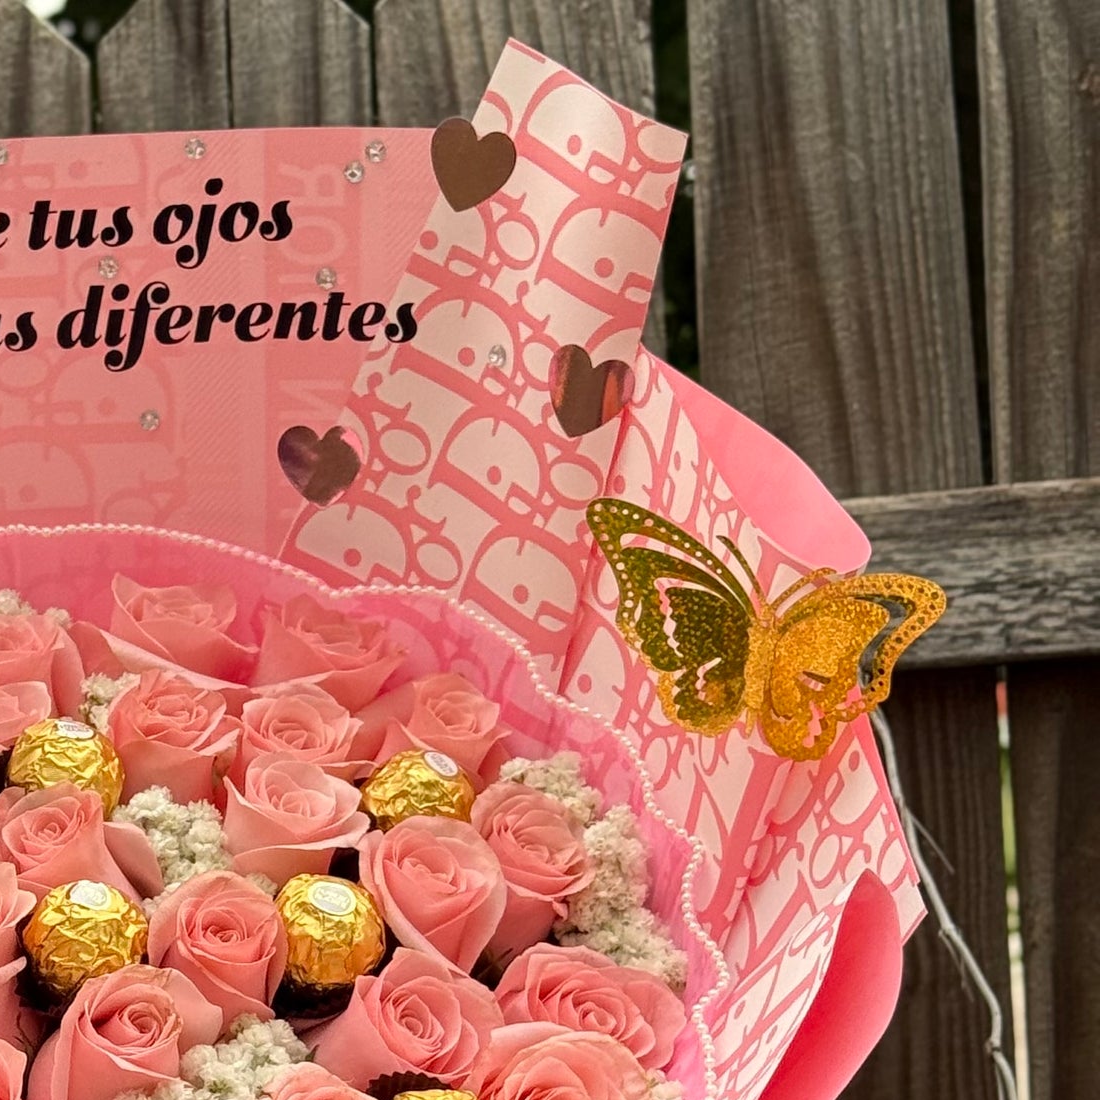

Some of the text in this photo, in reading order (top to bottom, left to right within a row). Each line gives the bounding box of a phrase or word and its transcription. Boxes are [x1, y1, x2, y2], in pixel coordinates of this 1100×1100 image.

[28, 200, 134, 251] tus
[153, 178, 293, 269] ojos
[57, 281, 418, 372] diferentes
